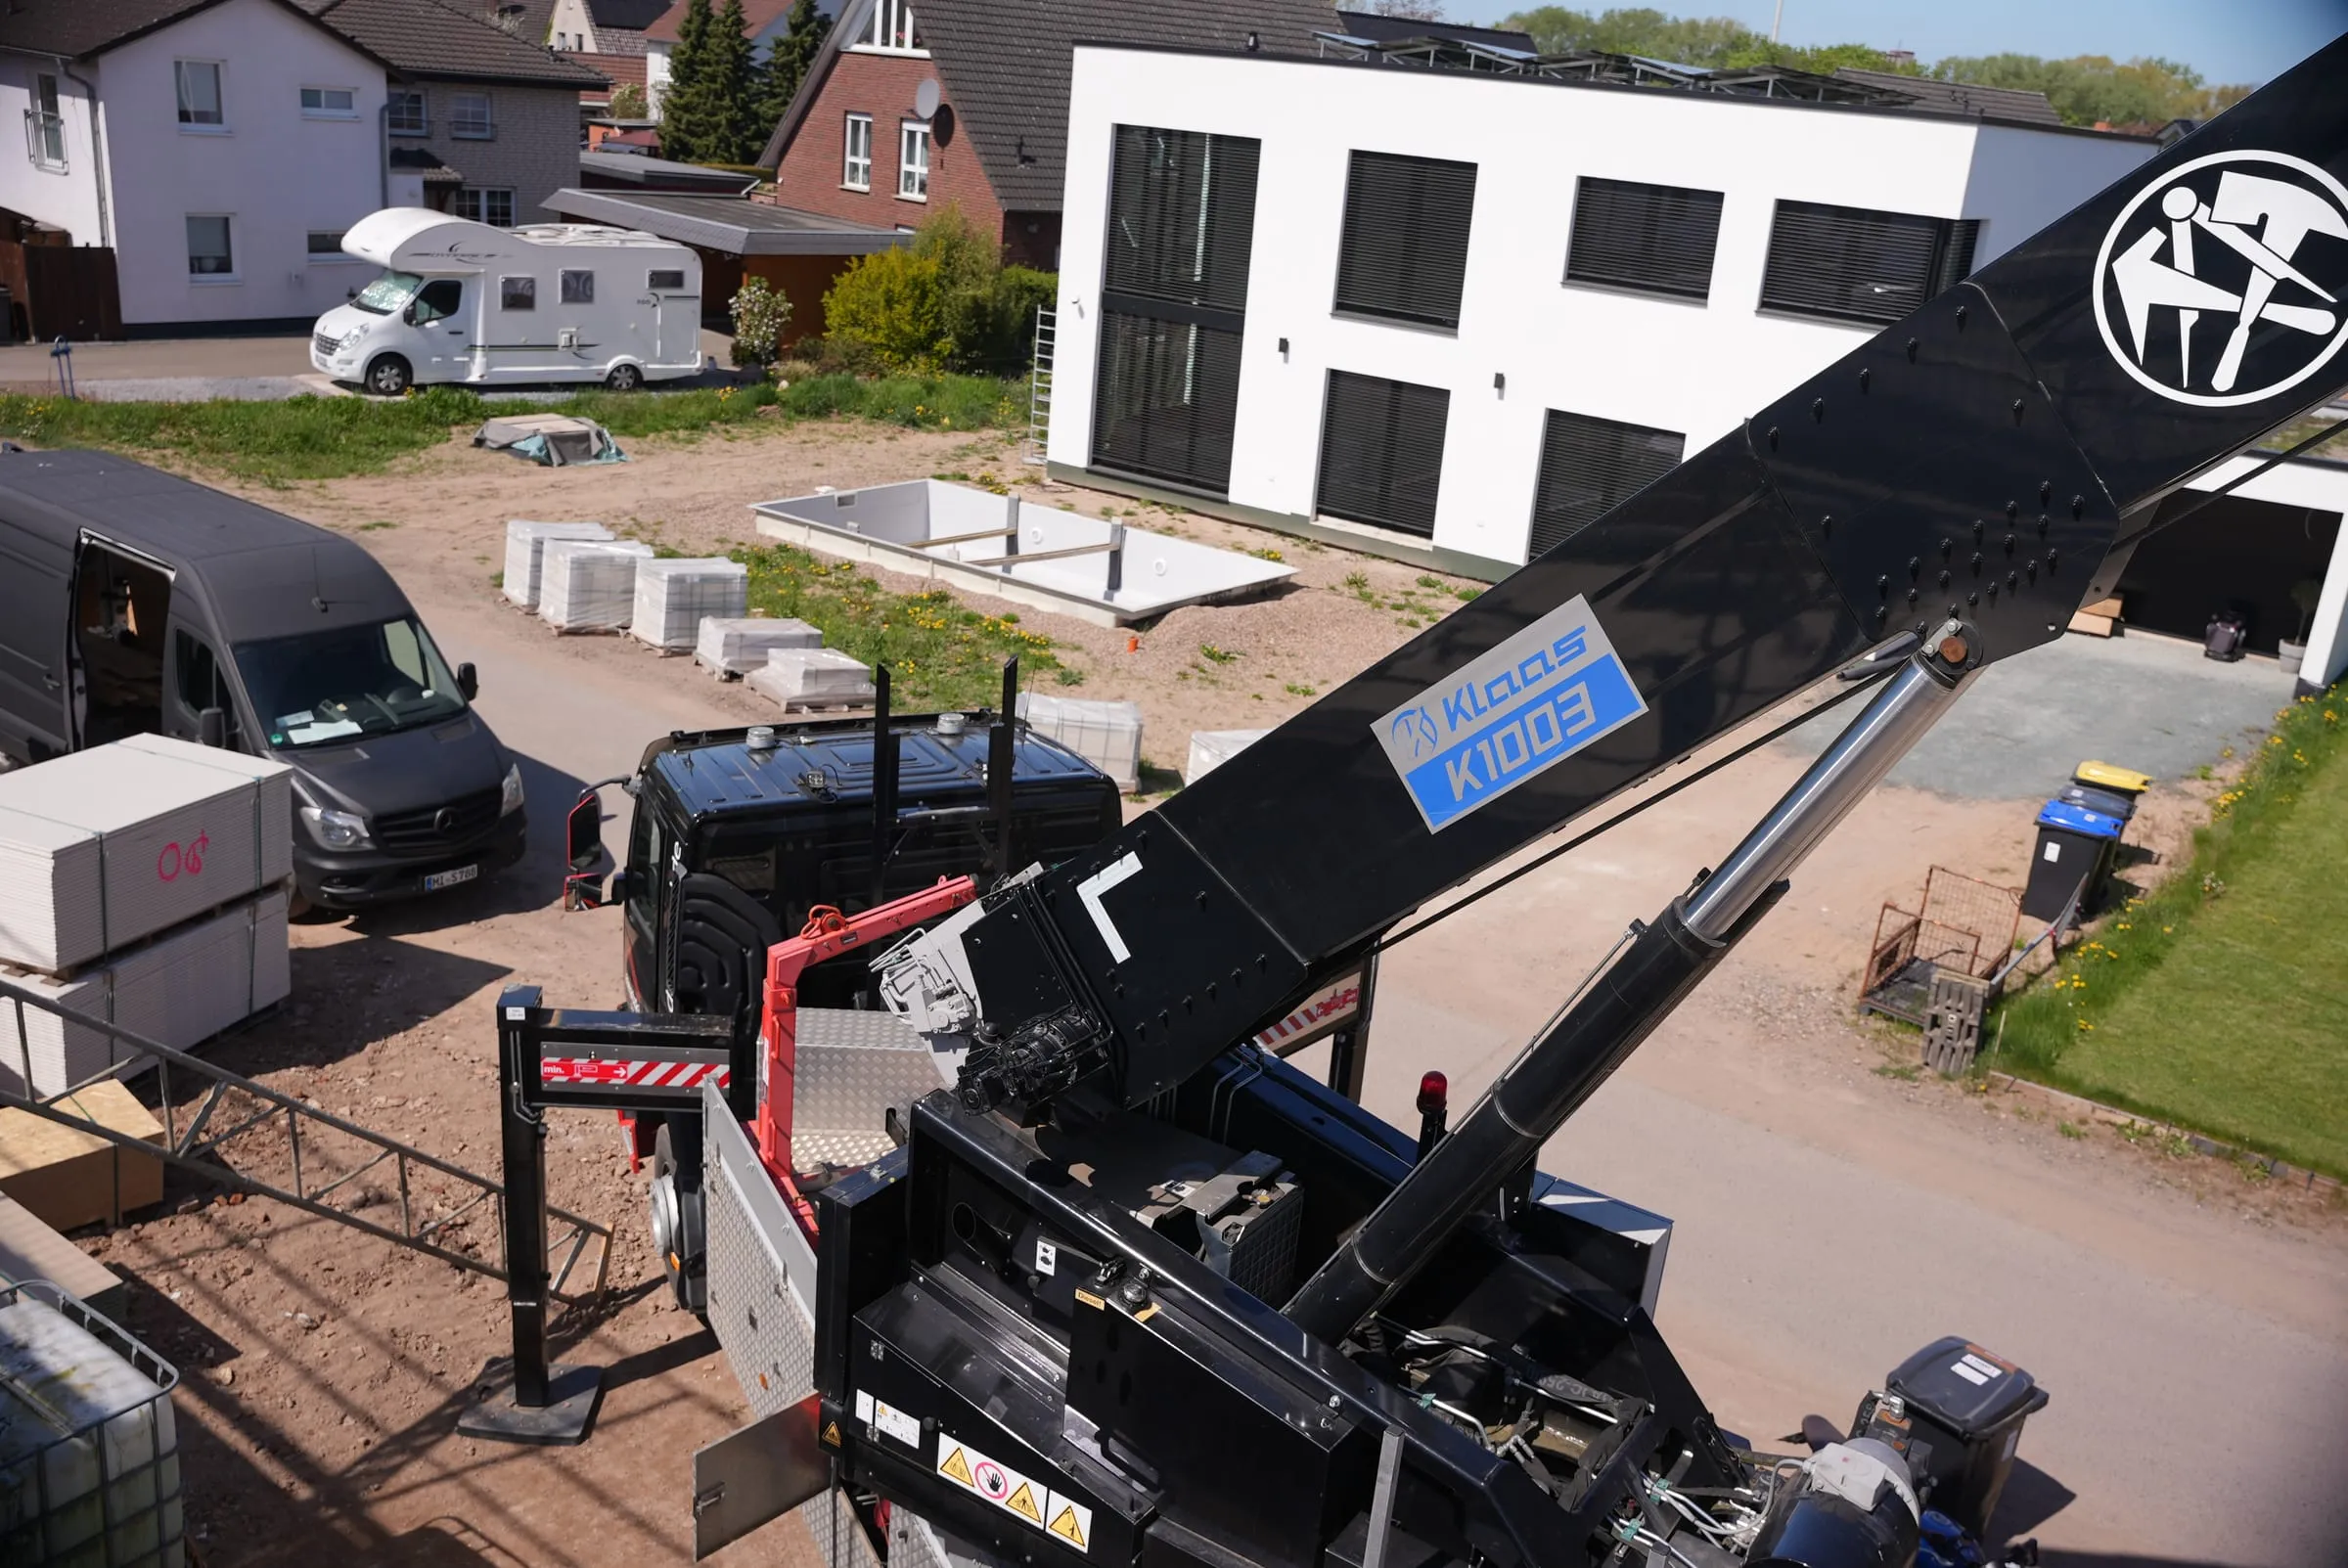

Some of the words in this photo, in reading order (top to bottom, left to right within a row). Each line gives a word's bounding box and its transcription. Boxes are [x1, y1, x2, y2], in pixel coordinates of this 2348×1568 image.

[1441, 625, 1587, 733] Klaas
[1444, 680, 1597, 802] K1003
[543, 1065, 564, 1074] min.
